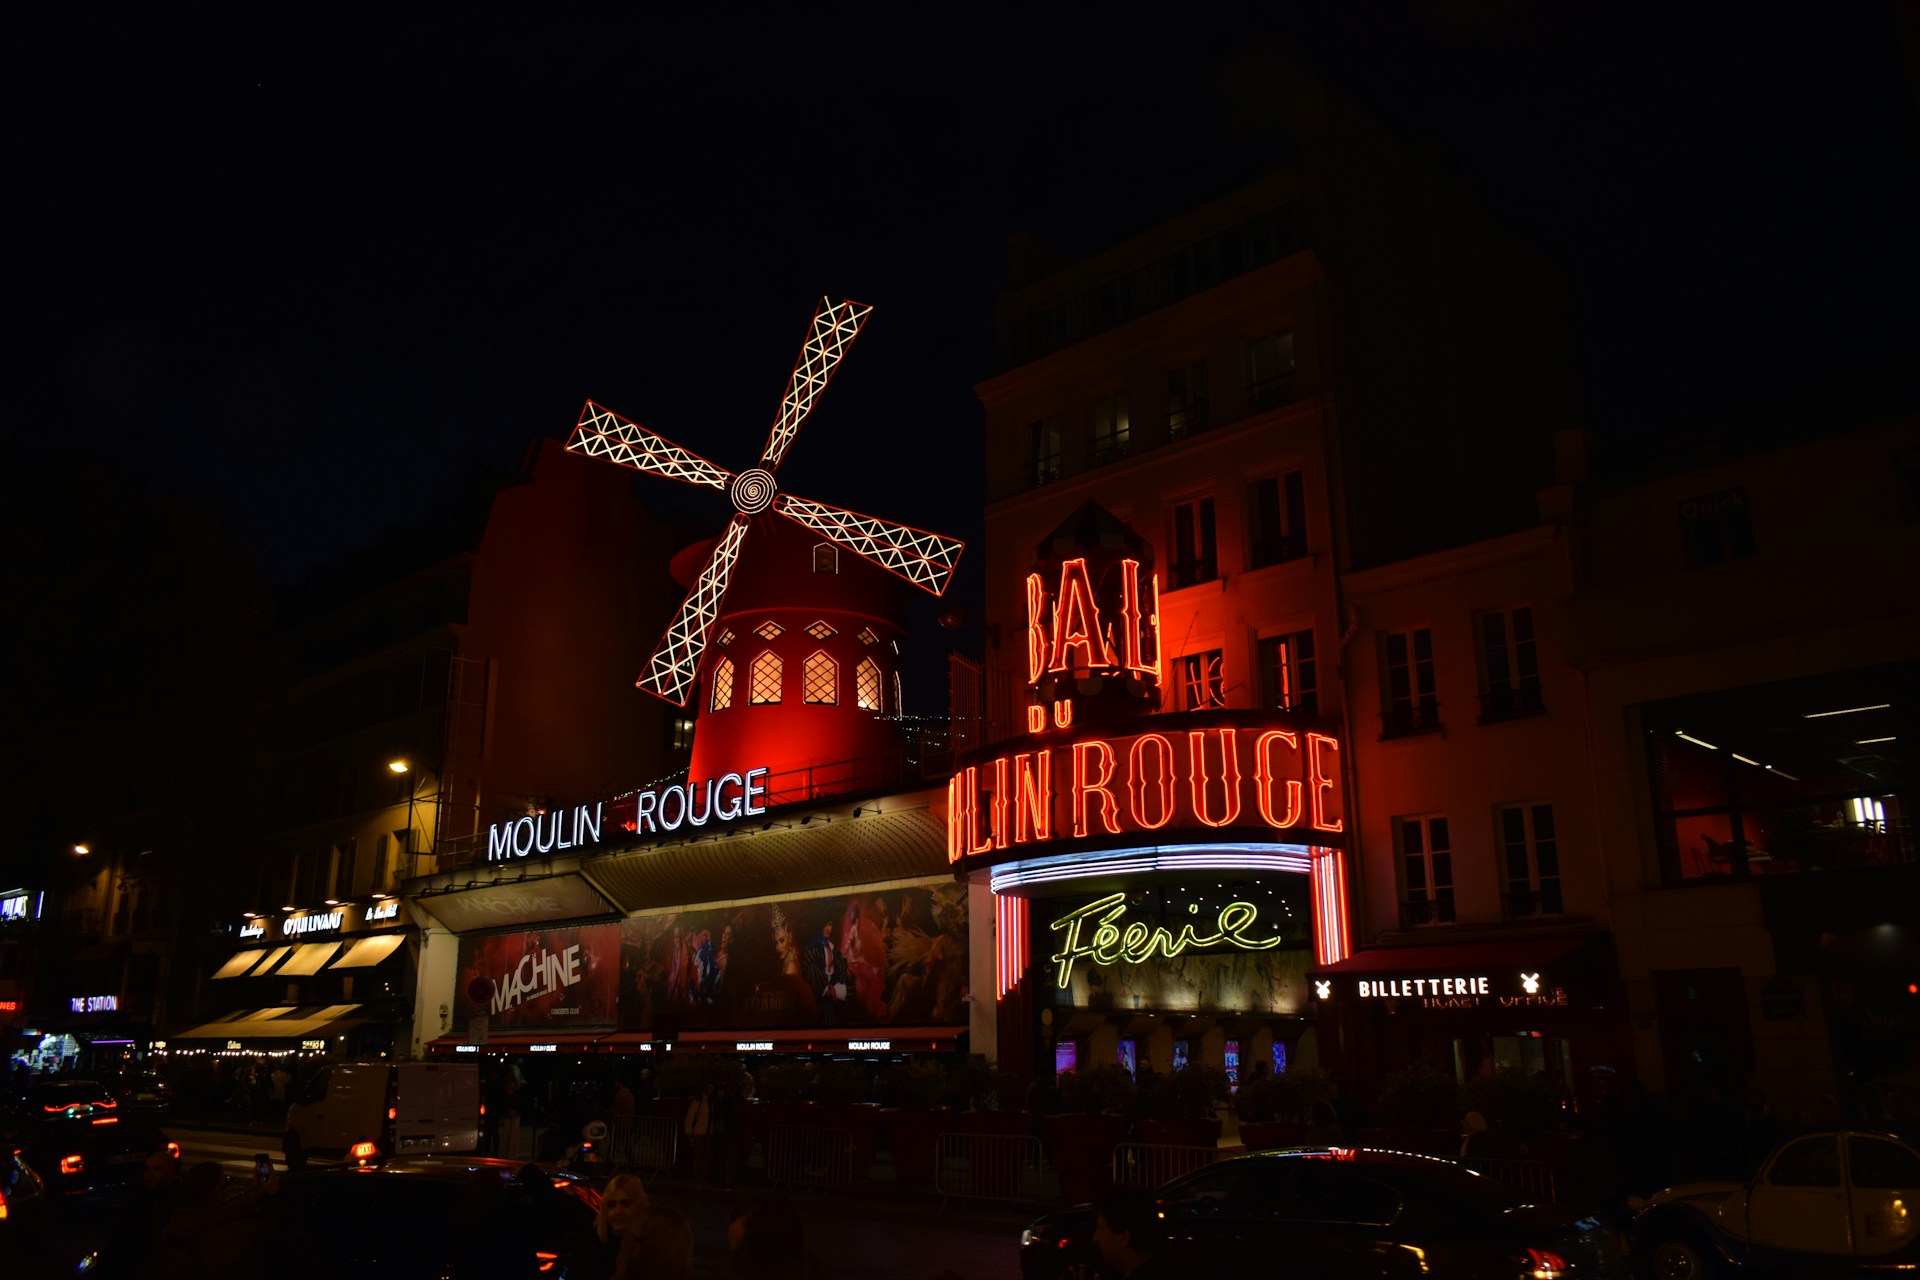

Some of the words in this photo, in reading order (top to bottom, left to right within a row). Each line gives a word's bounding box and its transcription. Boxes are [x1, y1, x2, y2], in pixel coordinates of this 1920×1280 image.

[1682, 491, 1744, 520] Quick
[1027, 558, 1162, 686] BAL
[1028, 699, 1072, 733] DU
[1072, 728, 1343, 838] ROUGE
[488, 801, 602, 861] MOULIN
[636, 767, 768, 835] ROUGE
[1050, 892, 1281, 989] Féerie
[490, 943, 582, 1016] MACHINE
[1358, 976, 1490, 998] BILLETTERIE
[71, 997, 86, 1013] THE
[88, 995, 118, 1013] STATION
[737, 1043, 755, 1051] MOULIN
[849, 1042, 870, 1050] MOULIN
[870, 1042, 891, 1050] ROUGE
[358, 1145, 372, 1155] TAXI
